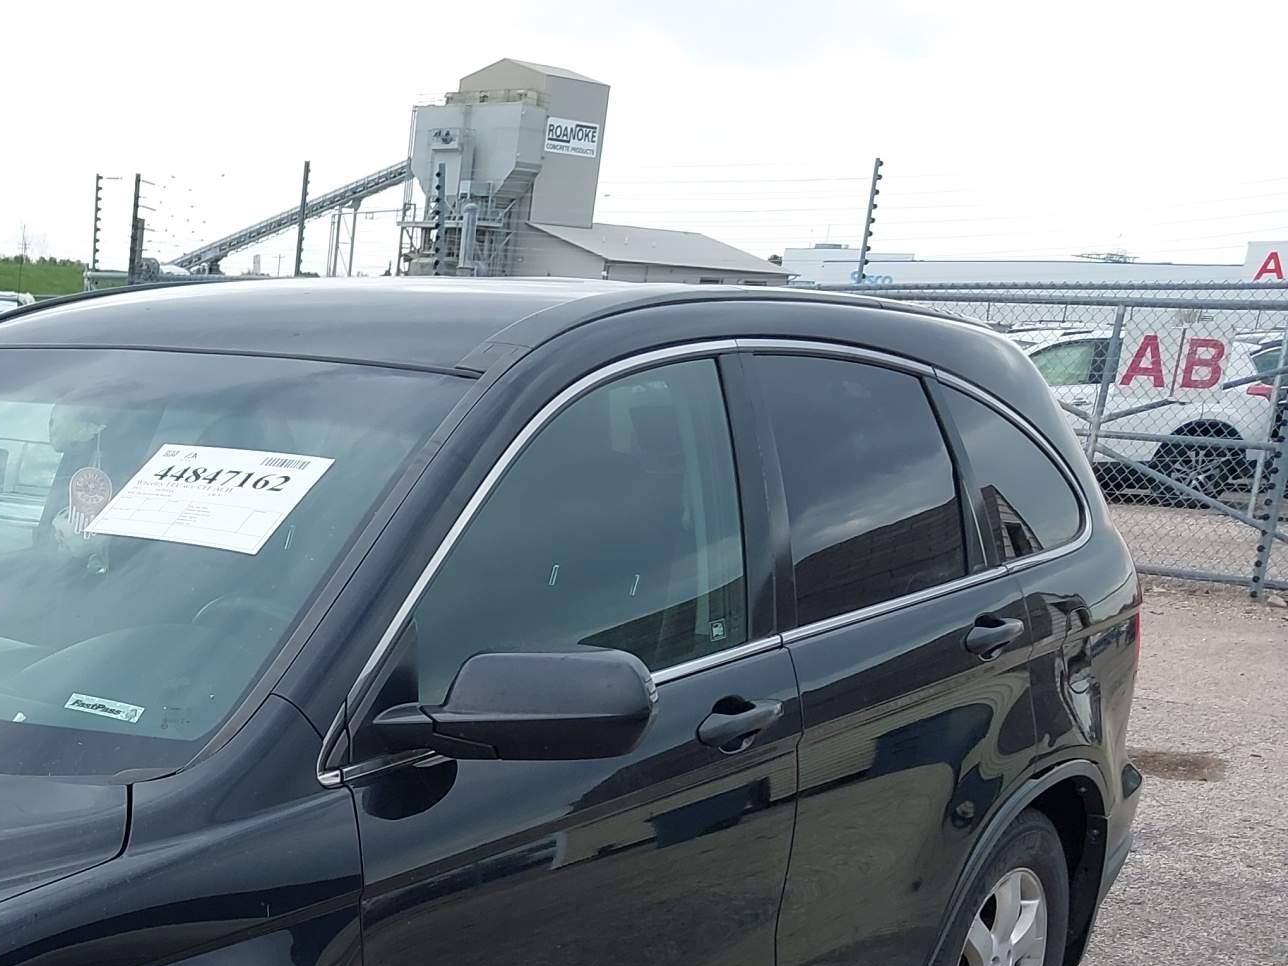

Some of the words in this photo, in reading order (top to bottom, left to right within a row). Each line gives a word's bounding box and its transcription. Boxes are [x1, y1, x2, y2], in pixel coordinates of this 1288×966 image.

[548, 123, 597, 143] ROANOKE
[545, 143, 570, 152] CONCRETE
[154, 464, 291, 492] 44847162
